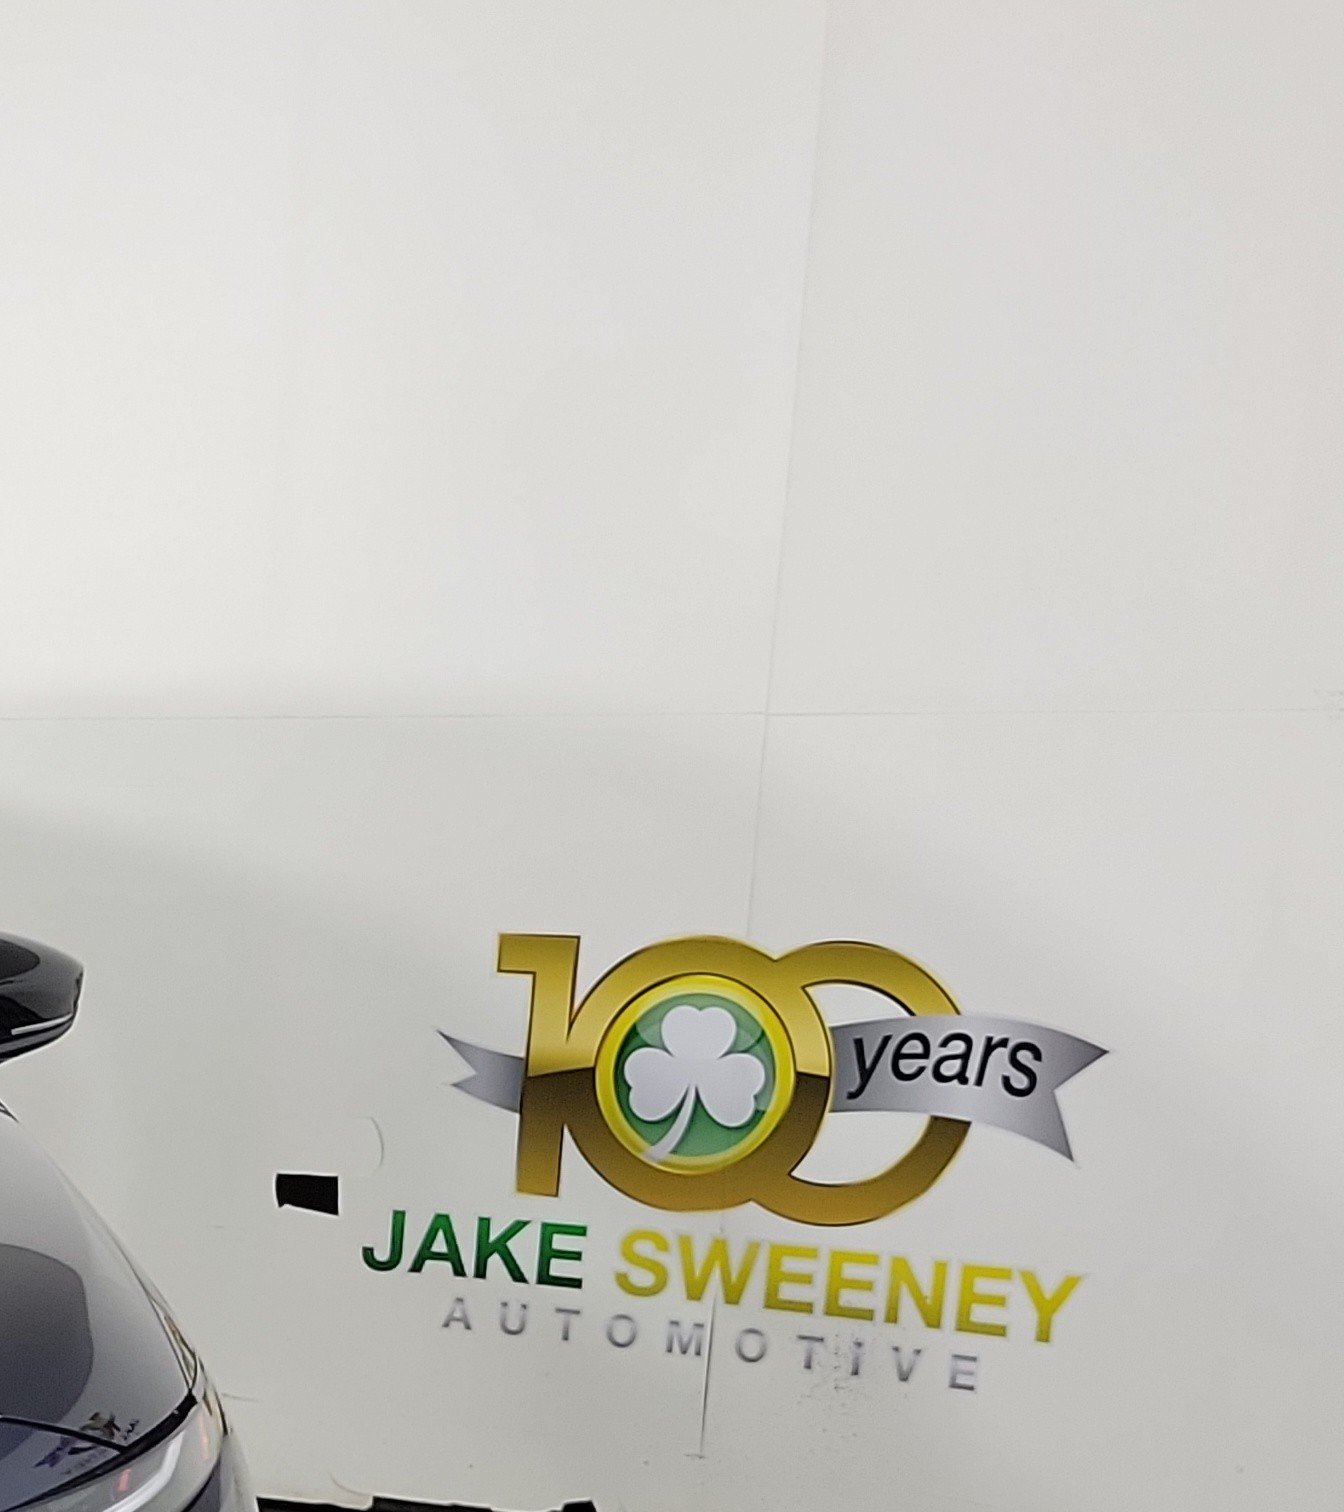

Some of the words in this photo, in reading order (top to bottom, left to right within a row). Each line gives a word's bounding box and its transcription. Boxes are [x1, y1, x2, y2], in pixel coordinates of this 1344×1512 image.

[497, 933, 972, 1227] 100
[847, 1031, 1043, 1100] years
[362, 1209, 587, 1290] JAKE
[614, 1228, 1082, 1344] SWEENEY
[442, 1297, 980, 1392] AUTOMOTIVE
